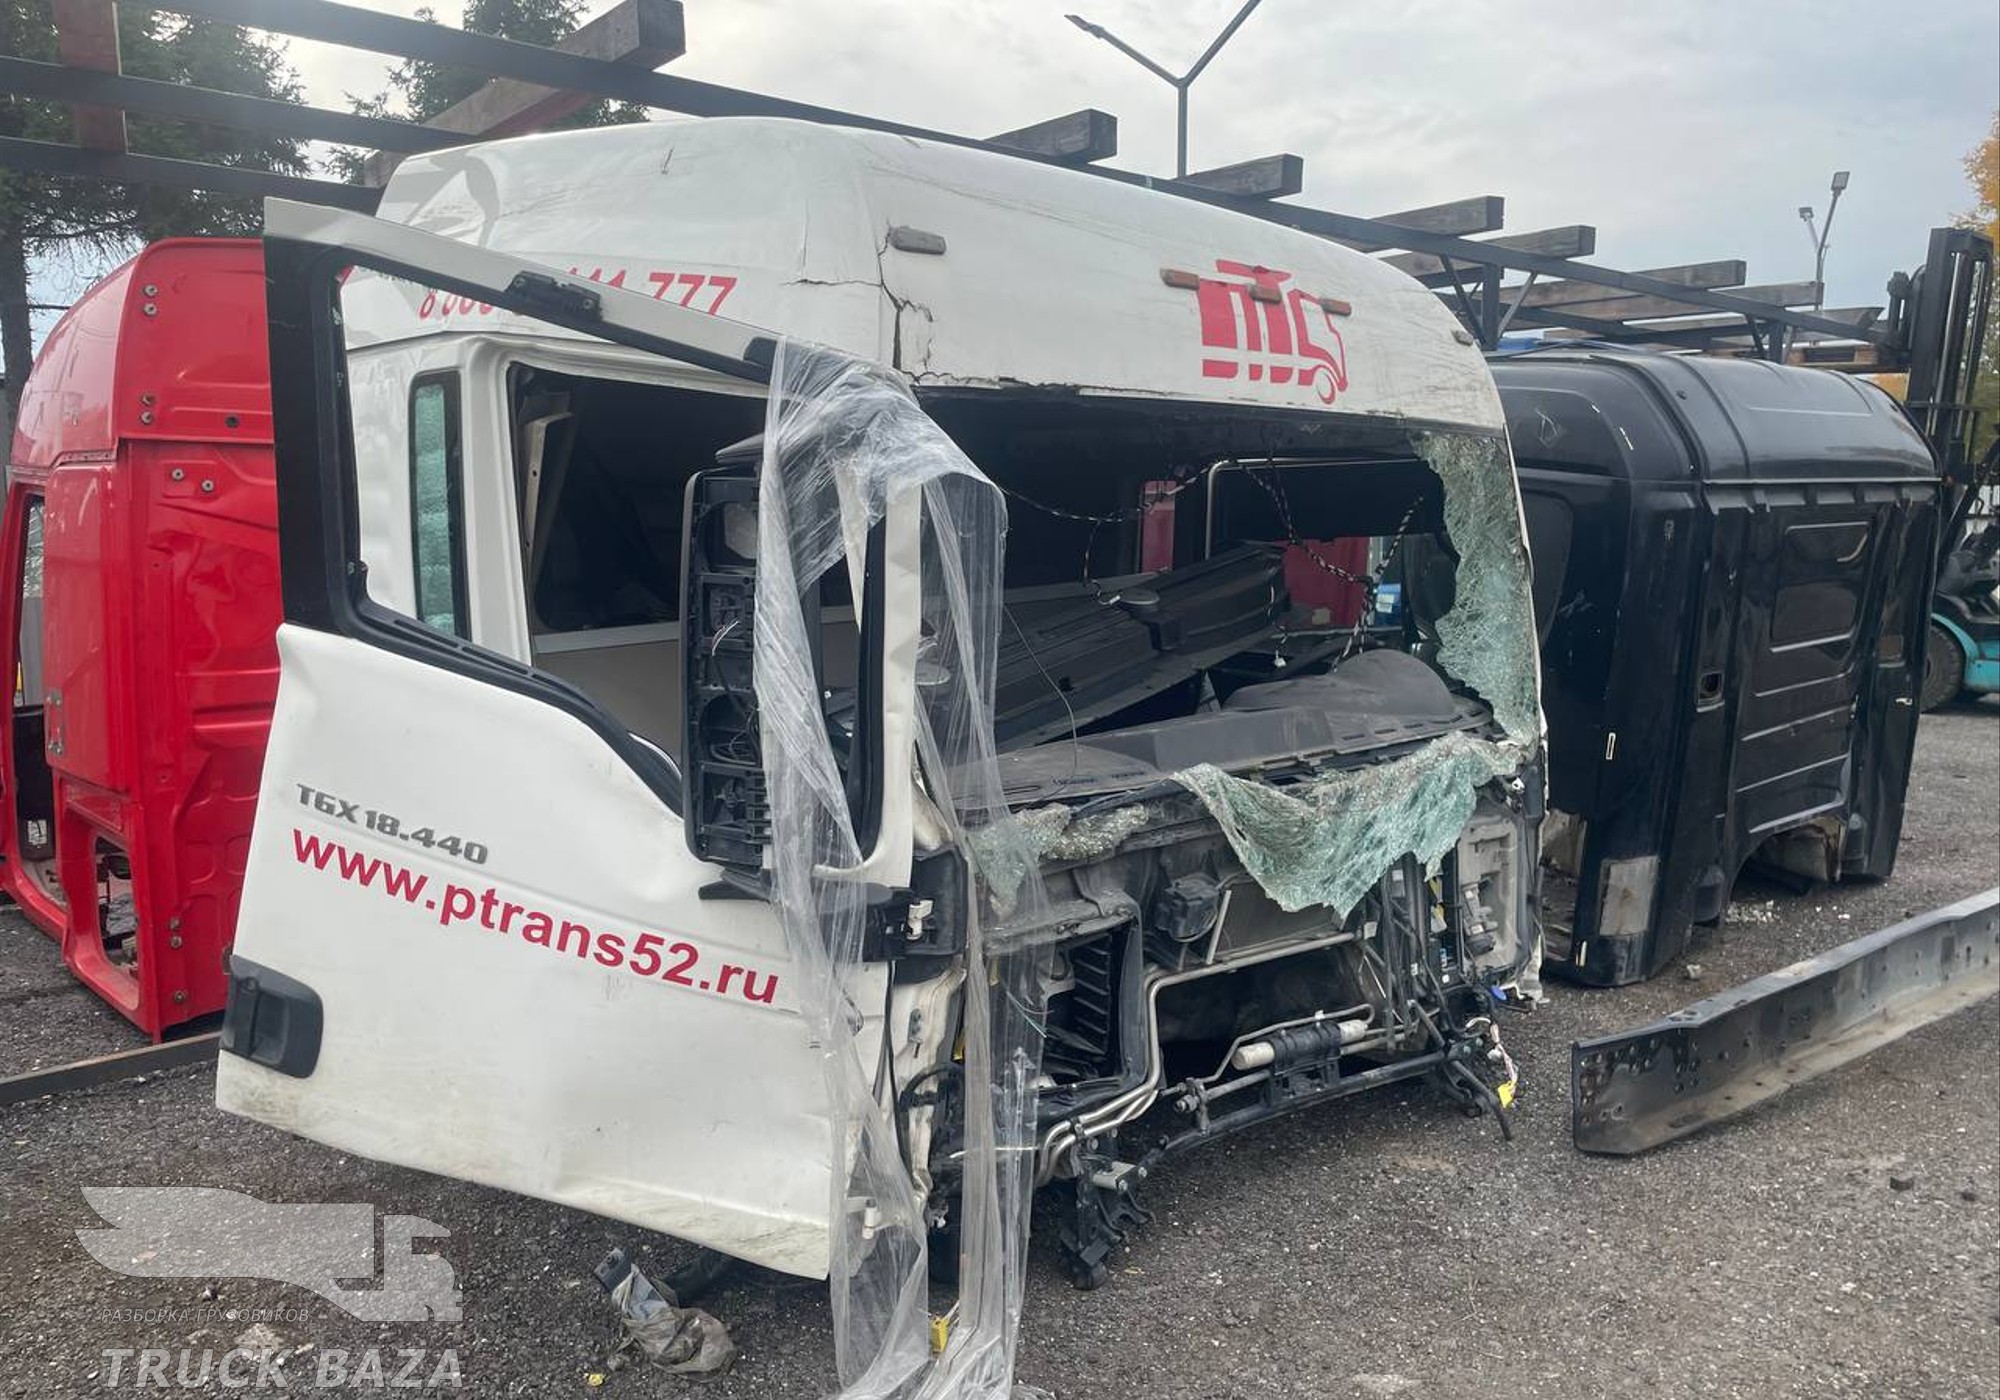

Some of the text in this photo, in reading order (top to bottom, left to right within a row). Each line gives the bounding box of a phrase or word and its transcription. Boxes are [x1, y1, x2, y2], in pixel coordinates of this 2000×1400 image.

[649, 271, 738, 317] 777
[296, 783, 489, 865] TGX 18.440
[292, 827, 779, 1004] www.ptrans52.ru
